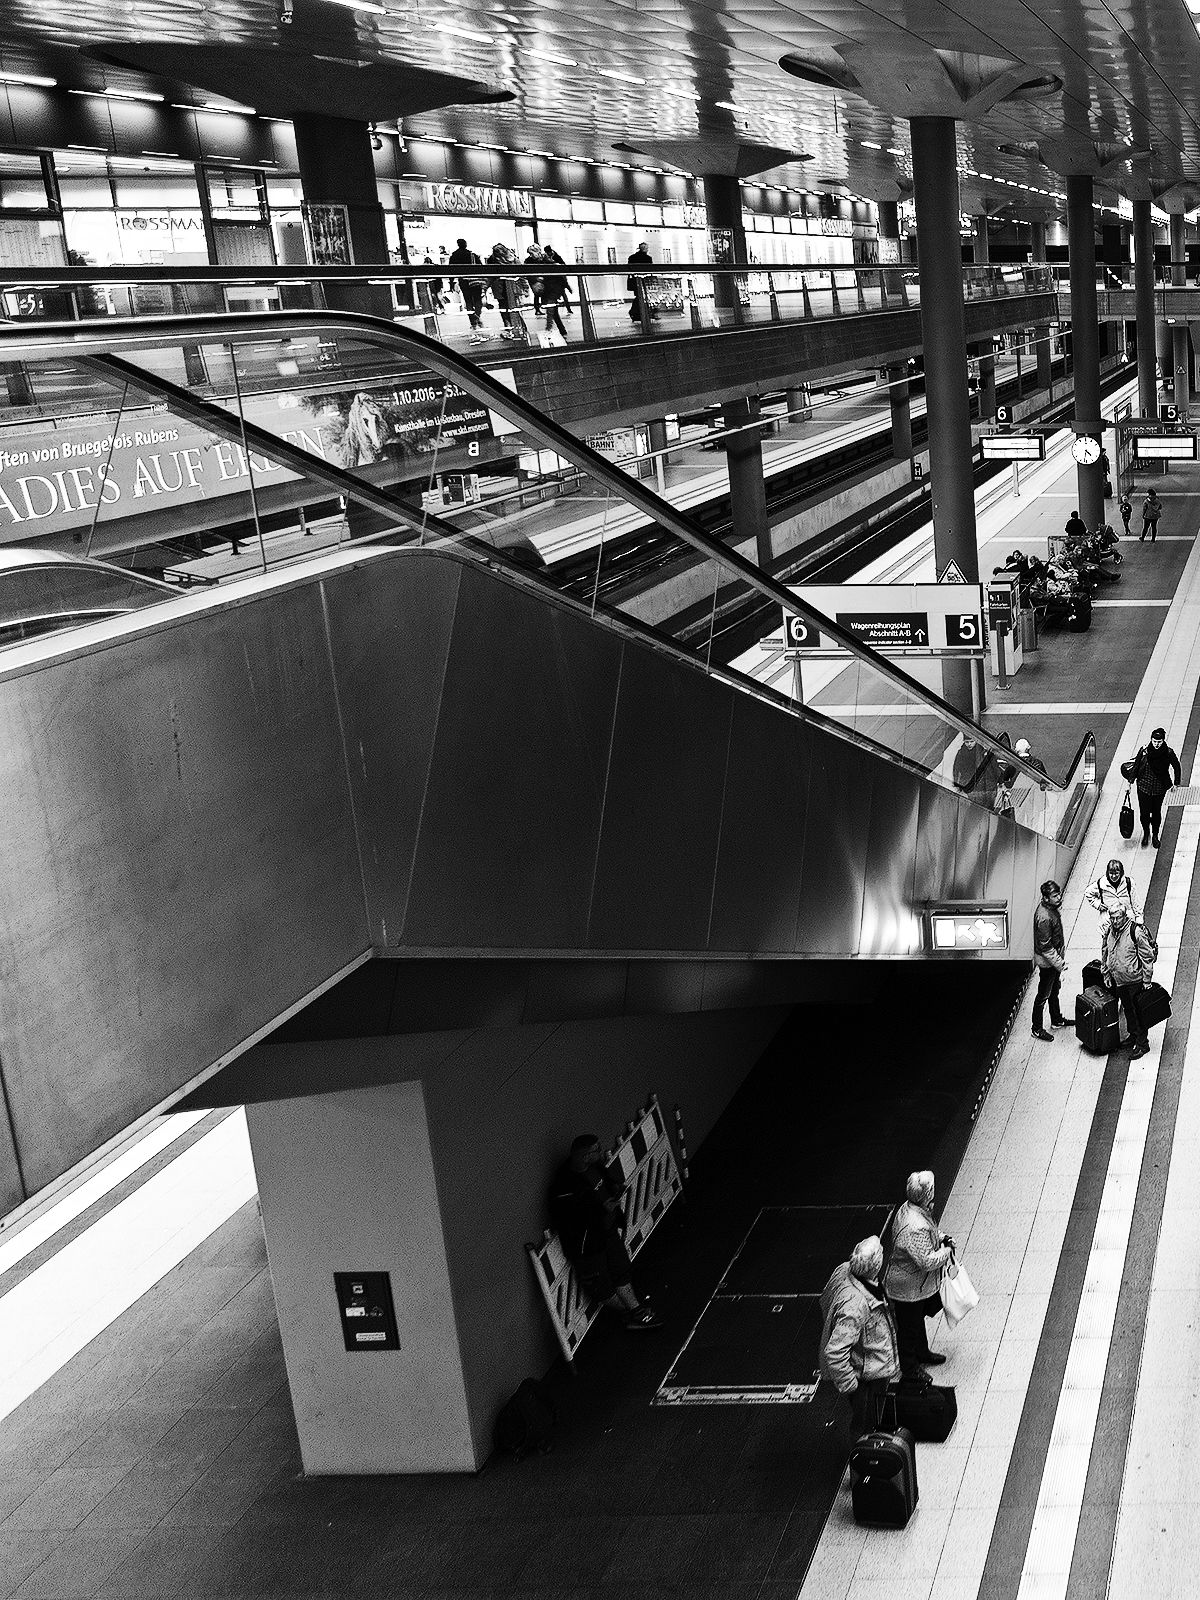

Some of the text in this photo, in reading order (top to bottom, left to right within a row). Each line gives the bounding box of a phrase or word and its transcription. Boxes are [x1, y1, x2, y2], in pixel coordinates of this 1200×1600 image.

[424, 185, 533, 217] ROSSMANN
[393, 387, 436, 405] 1.10.2016
[997, 407, 1006, 420] 6
[1167, 406, 1176, 419] 5
[32, 448, 60, 463] von
[135, 429, 179, 447] Rubens
[132, 447, 204, 499] AUF
[790, 616, 808, 641] 6
[851, 622, 911, 630] Wagenreihungsplan
[959, 615, 976, 639] 5
